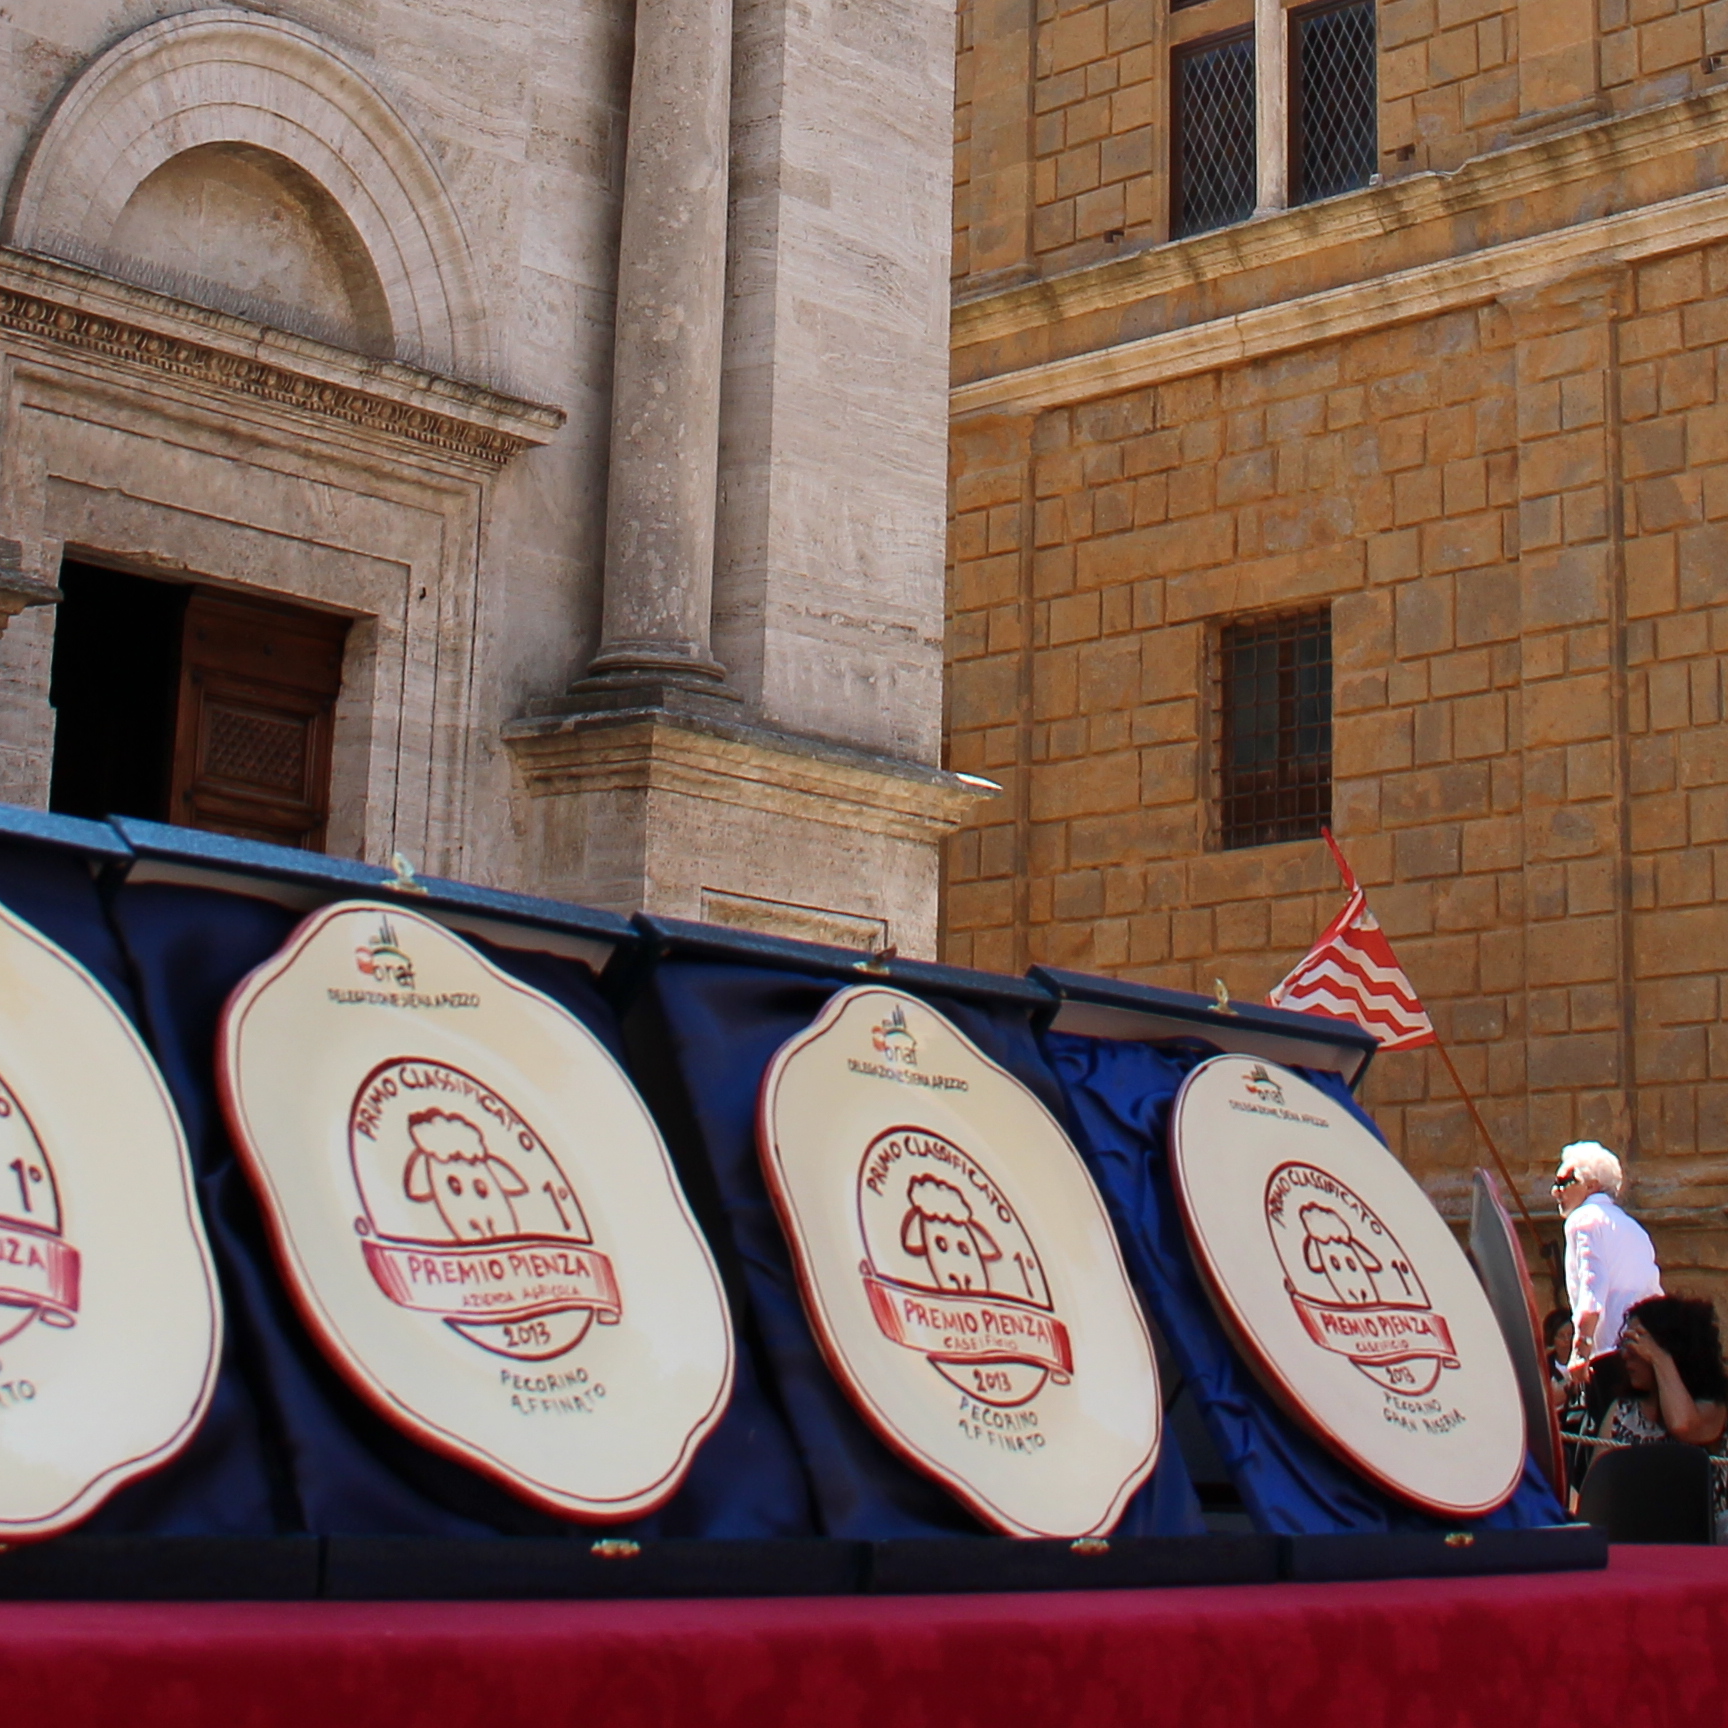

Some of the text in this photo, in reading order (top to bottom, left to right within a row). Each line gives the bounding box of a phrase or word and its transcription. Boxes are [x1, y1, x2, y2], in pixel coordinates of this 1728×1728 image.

[355, 1066, 534, 1152] PRIMO CLASSIFICATO
[866, 1135, 1012, 1224] PRIMO CLASSIFICATO
[1287, 1169, 1383, 1235] CLASSIFICATO
[407, 1253, 591, 1285] PREMIO PIENZA
[503, 1321, 552, 1348] 2013
[902, 1298, 1049, 1344] PREMIO PIENZA
[1320, 1312, 1436, 1337] PREMIO PIENZA
[500, 1367, 590, 1393] PECORINO
[973, 1368, 1012, 1392] 2013
[511, 1383, 607, 1416] AFFINATO
[959, 1396, 1039, 1430] PECORINO
